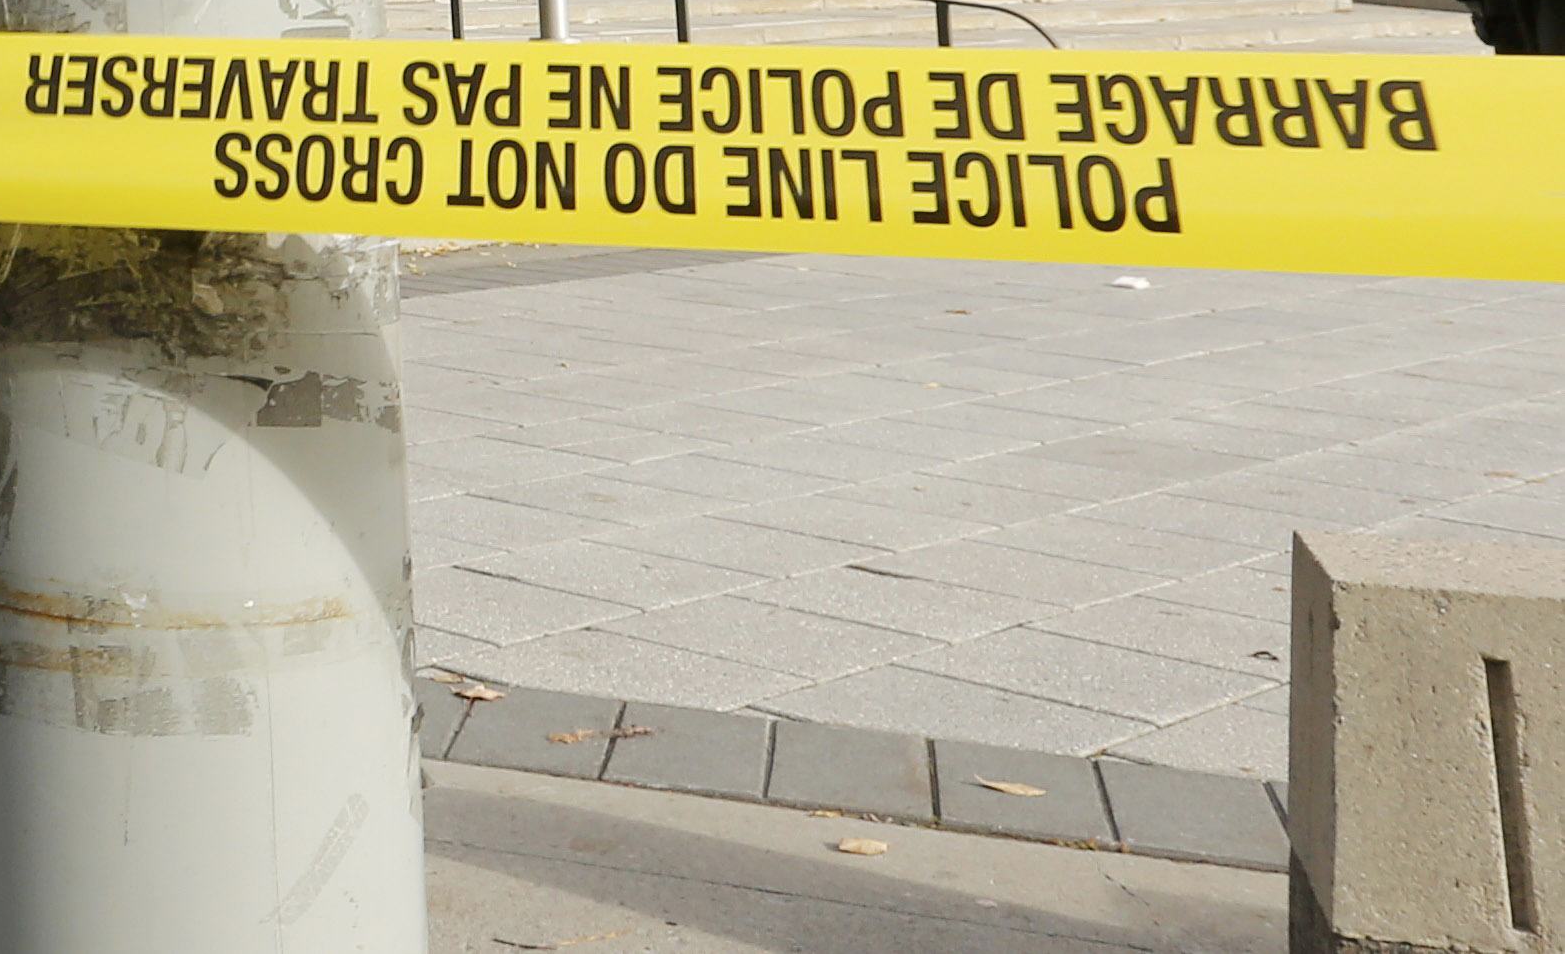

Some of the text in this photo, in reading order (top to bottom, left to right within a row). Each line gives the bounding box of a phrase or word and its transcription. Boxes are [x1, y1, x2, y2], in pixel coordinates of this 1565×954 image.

[25, 54, 1439, 152] BARRAGE DE POLICE NE PAS TRAVERSER
[214, 132, 1182, 234] POLICE LINE DO NOT CROSS
